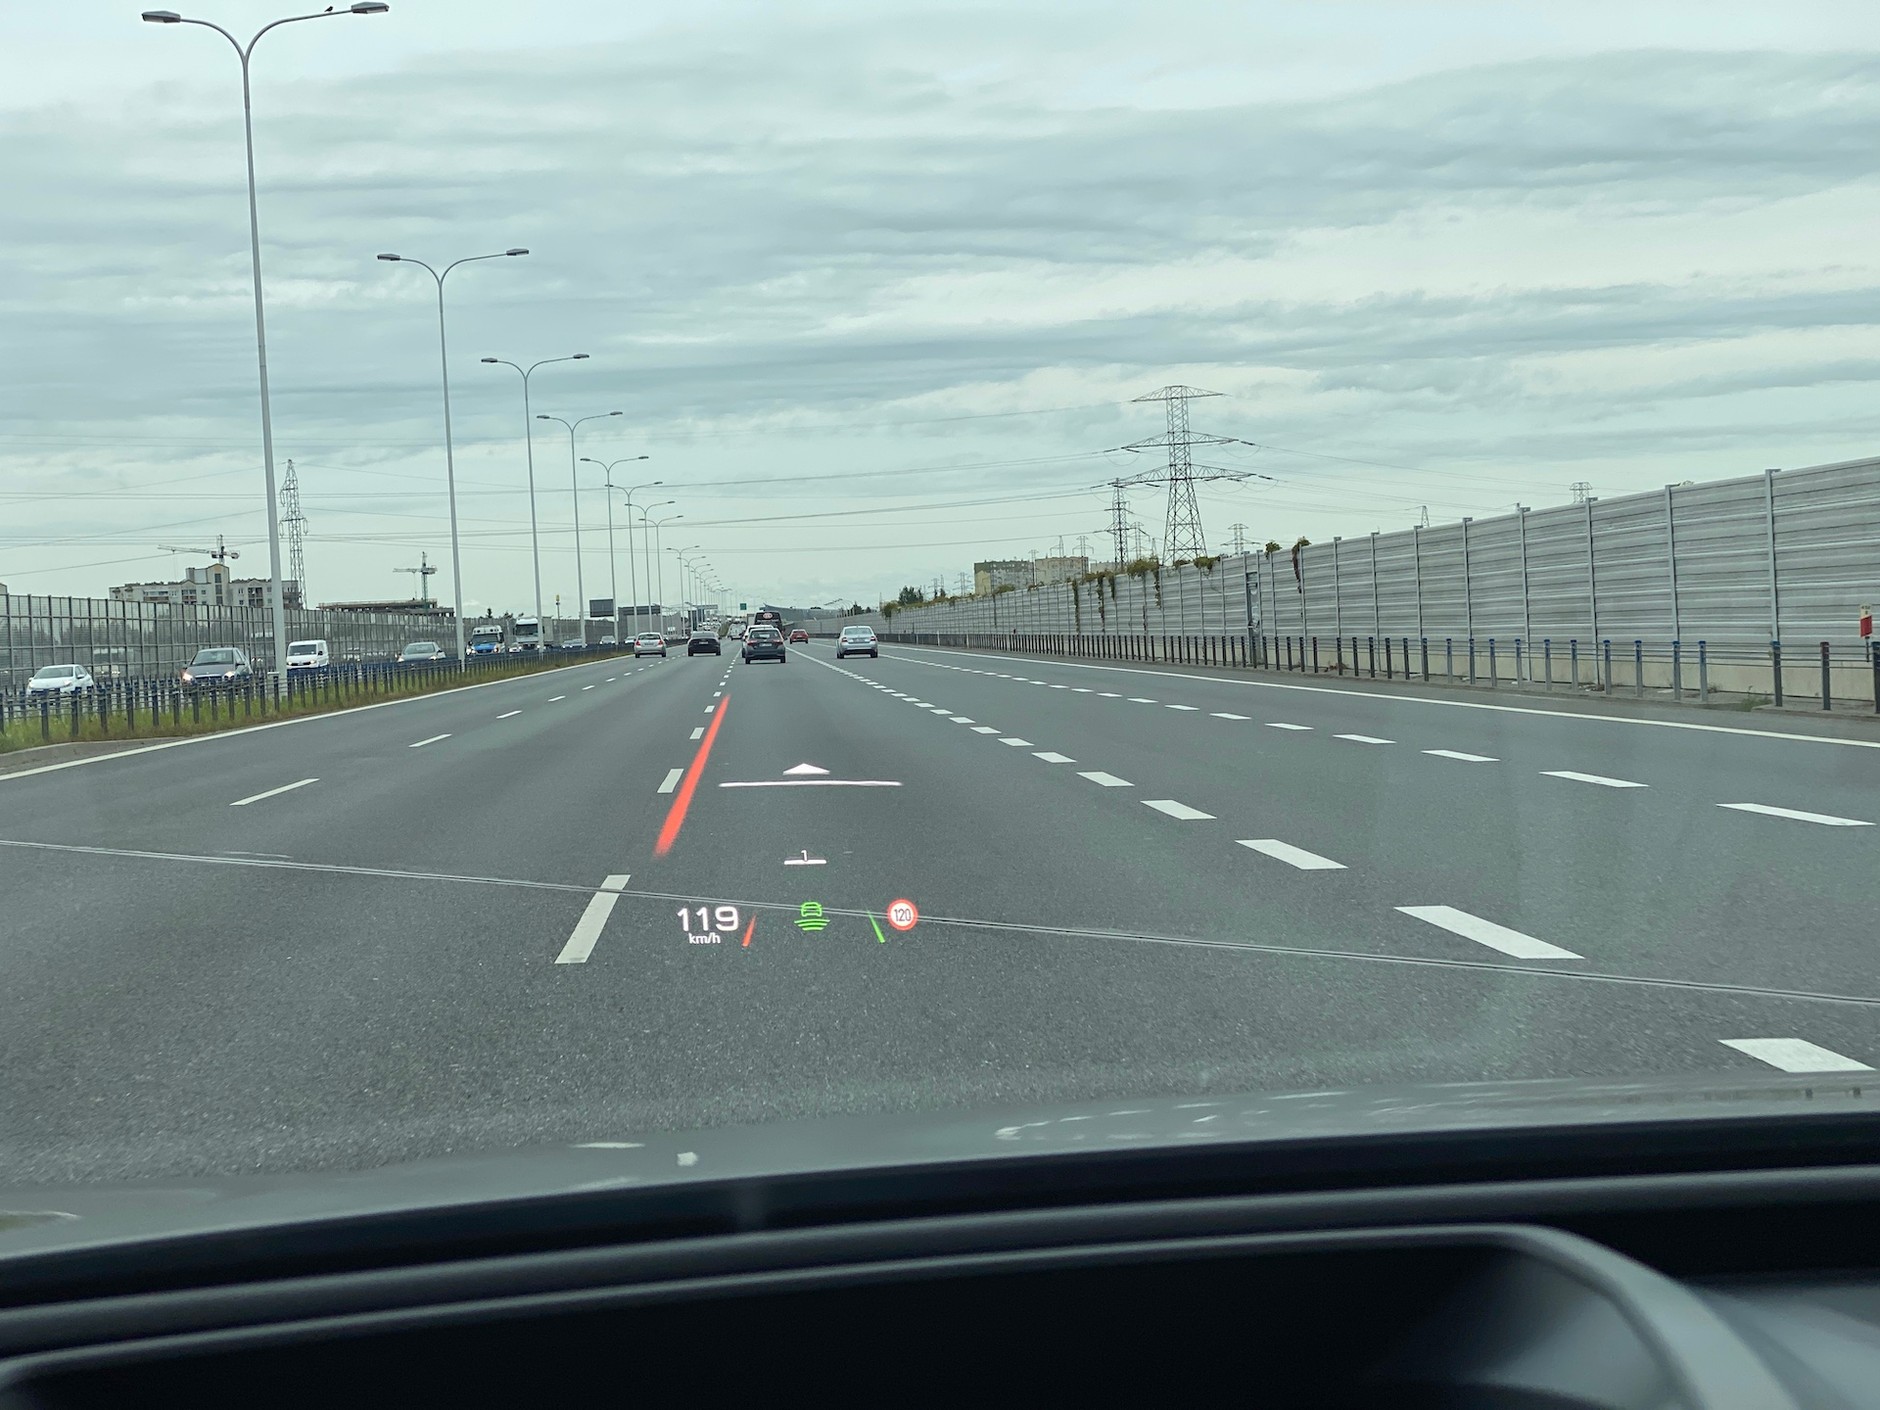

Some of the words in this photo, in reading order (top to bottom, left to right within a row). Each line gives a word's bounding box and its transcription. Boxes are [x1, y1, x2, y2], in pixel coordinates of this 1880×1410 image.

[677, 906, 739, 931] 119
[894, 908, 912, 922] 120
[688, 932, 721, 944] km/h
